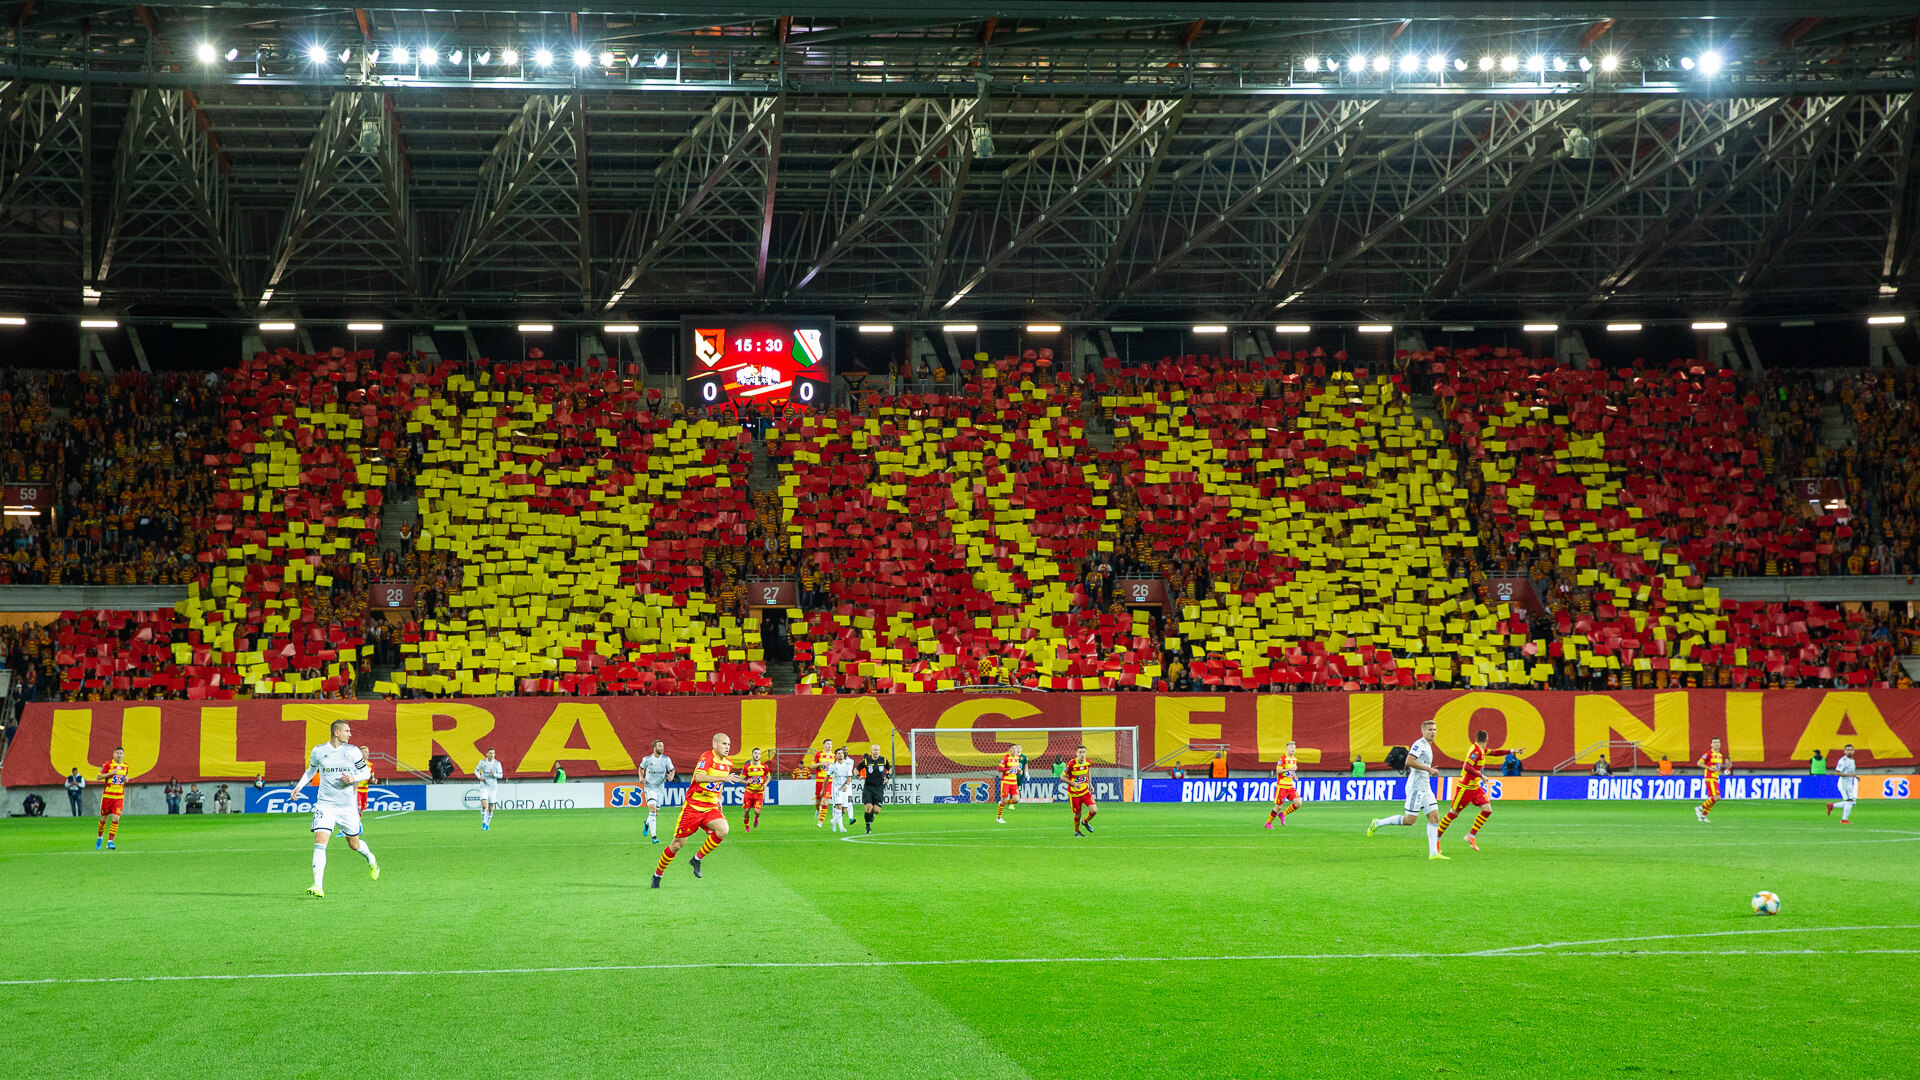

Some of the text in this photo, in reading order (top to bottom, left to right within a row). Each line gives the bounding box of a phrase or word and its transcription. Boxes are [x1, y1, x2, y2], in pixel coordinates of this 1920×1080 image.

[703, 382, 717, 401] 0
[800, 382, 814, 401] 0
[20, 488, 37, 500] 59
[386, 589, 403, 601] 28
[763, 587, 780, 600] 27
[1132, 584, 1149, 597] 26
[1497, 583, 1513, 595] 25
[50, 691, 1914, 782] ULTRA JAGIELLONIA
[611, 785, 644, 807] STS
[1182, 781, 1237, 802] BONUS
[1318, 781, 1341, 801] NA
[1346, 780, 1396, 800] START
[1588, 778, 1643, 800] BONUS
[1648, 779, 1684, 800] 1200
[1725, 778, 1747, 799] NA
[1751, 778, 1802, 799] START
[1882, 777, 1910, 799] STS
[494, 799, 575, 809] NORD AUTO
